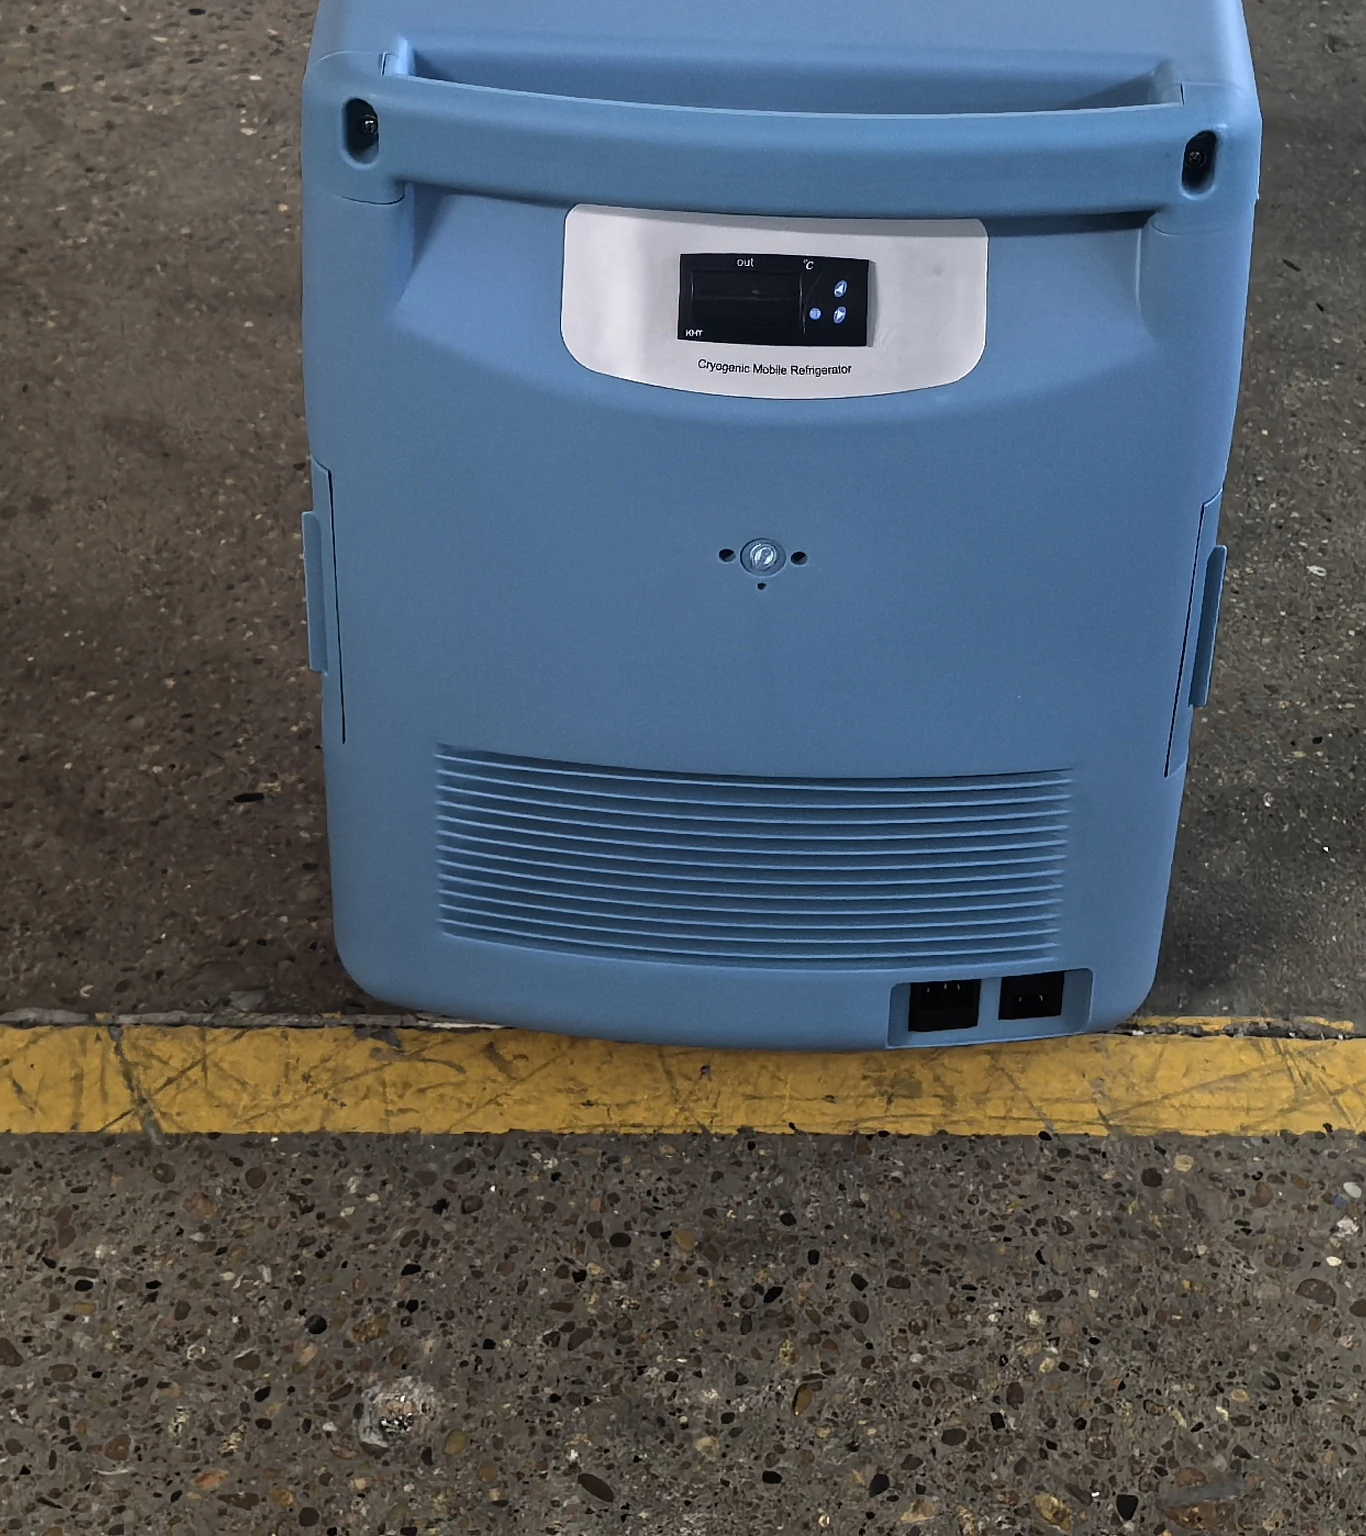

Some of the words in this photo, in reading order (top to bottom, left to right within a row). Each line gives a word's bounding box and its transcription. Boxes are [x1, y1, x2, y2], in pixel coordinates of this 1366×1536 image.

[697, 358, 750, 374] Cryogenic
[752, 363, 787, 376] Mobile
[790, 364, 852, 378] Refrigerator
